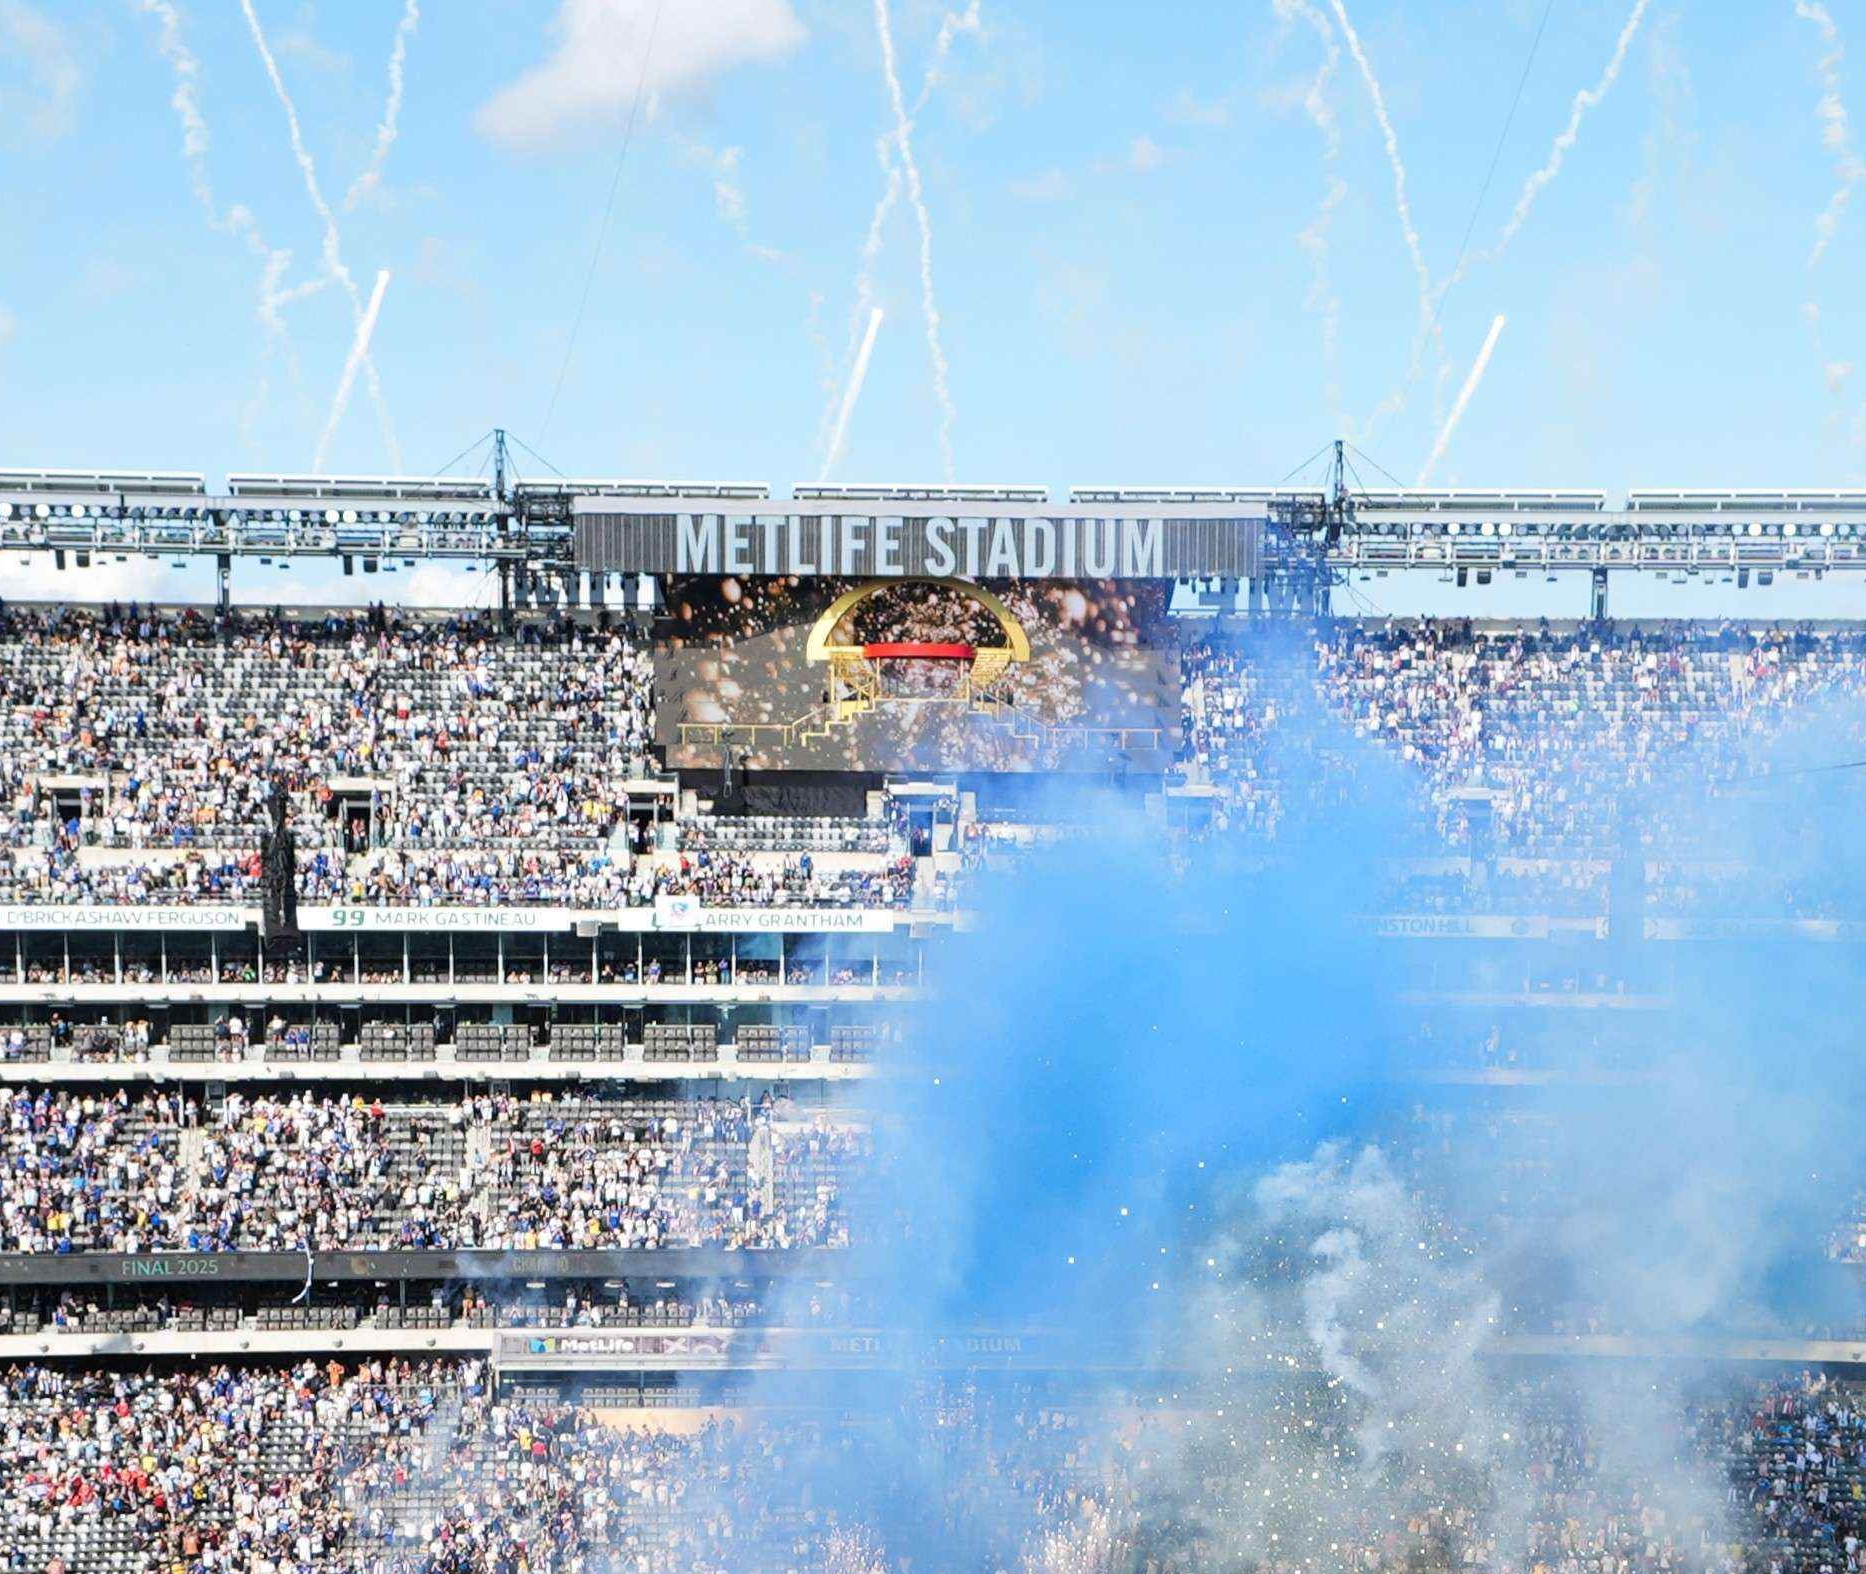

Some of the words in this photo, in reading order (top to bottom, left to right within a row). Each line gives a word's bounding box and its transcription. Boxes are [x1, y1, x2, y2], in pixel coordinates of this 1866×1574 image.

[678, 515, 904, 577] METLIFE
[924, 515, 1164, 578] STADIUM
[7, 911, 142, 925] D'BRICKASHAW
[147, 911, 240, 926] FERGUSON
[332, 910, 366, 927] 99
[376, 912, 430, 926] MARK
[435, 912, 536, 926] GASTINEAU
[697, 912, 752, 928] ARRY
[765, 912, 863, 927] GRANTHAM
[121, 1260, 174, 1276] FINAL
[177, 1259, 219, 1275] 2025
[561, 1339, 634, 1353] MetLife
